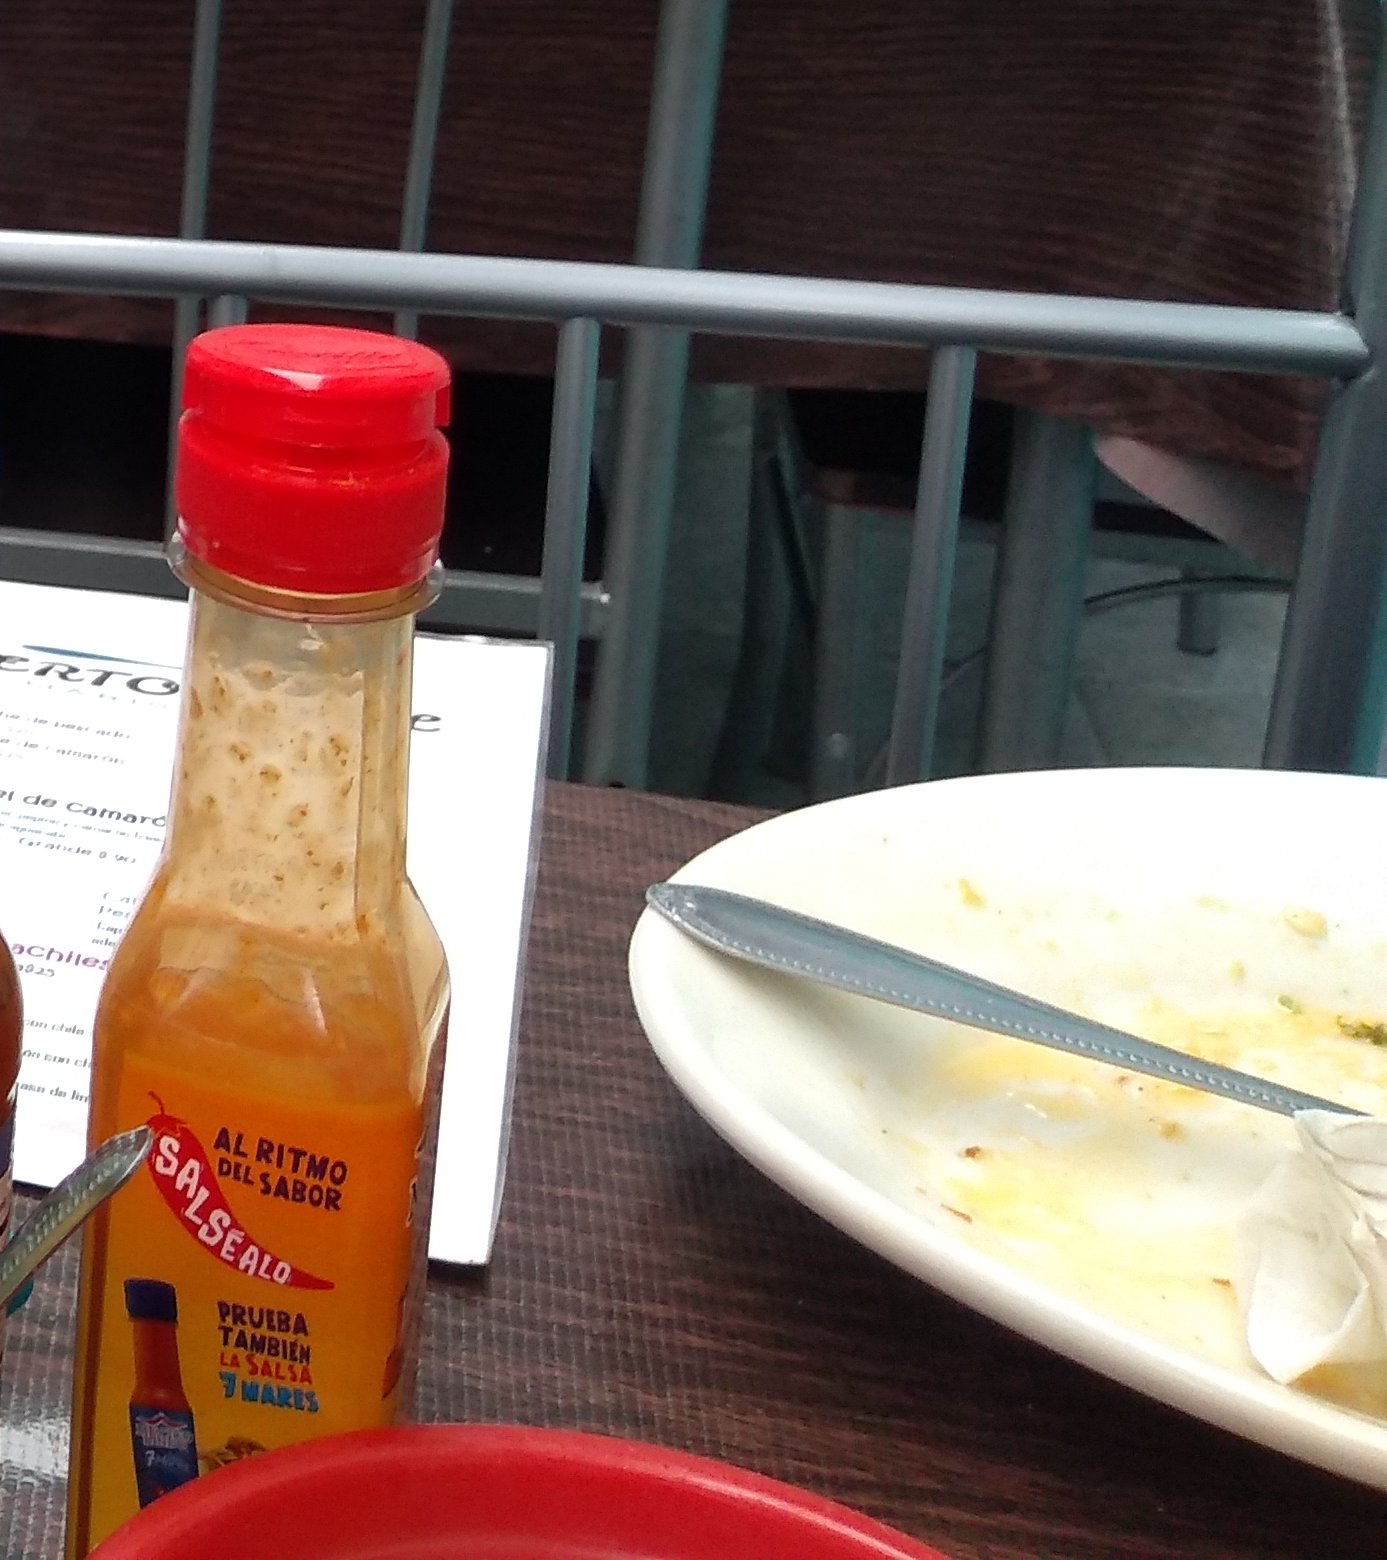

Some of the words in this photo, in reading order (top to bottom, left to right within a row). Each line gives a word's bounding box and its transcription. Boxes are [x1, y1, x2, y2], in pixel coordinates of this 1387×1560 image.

[213, 1126, 249, 1159] AL
[255, 1137, 348, 1186] RITMO
[217, 1157, 255, 1186] DEL
[259, 1171, 342, 1211] SABOR
[217, 1299, 309, 1336] PRUEBA
[217, 1325, 311, 1365] TAMBIÉN
[219, 1351, 241, 1368] LA
[245, 1352, 313, 1386] SALSA
[218, 1370, 237, 1398] 7
[241, 1379, 320, 1413] MARES
